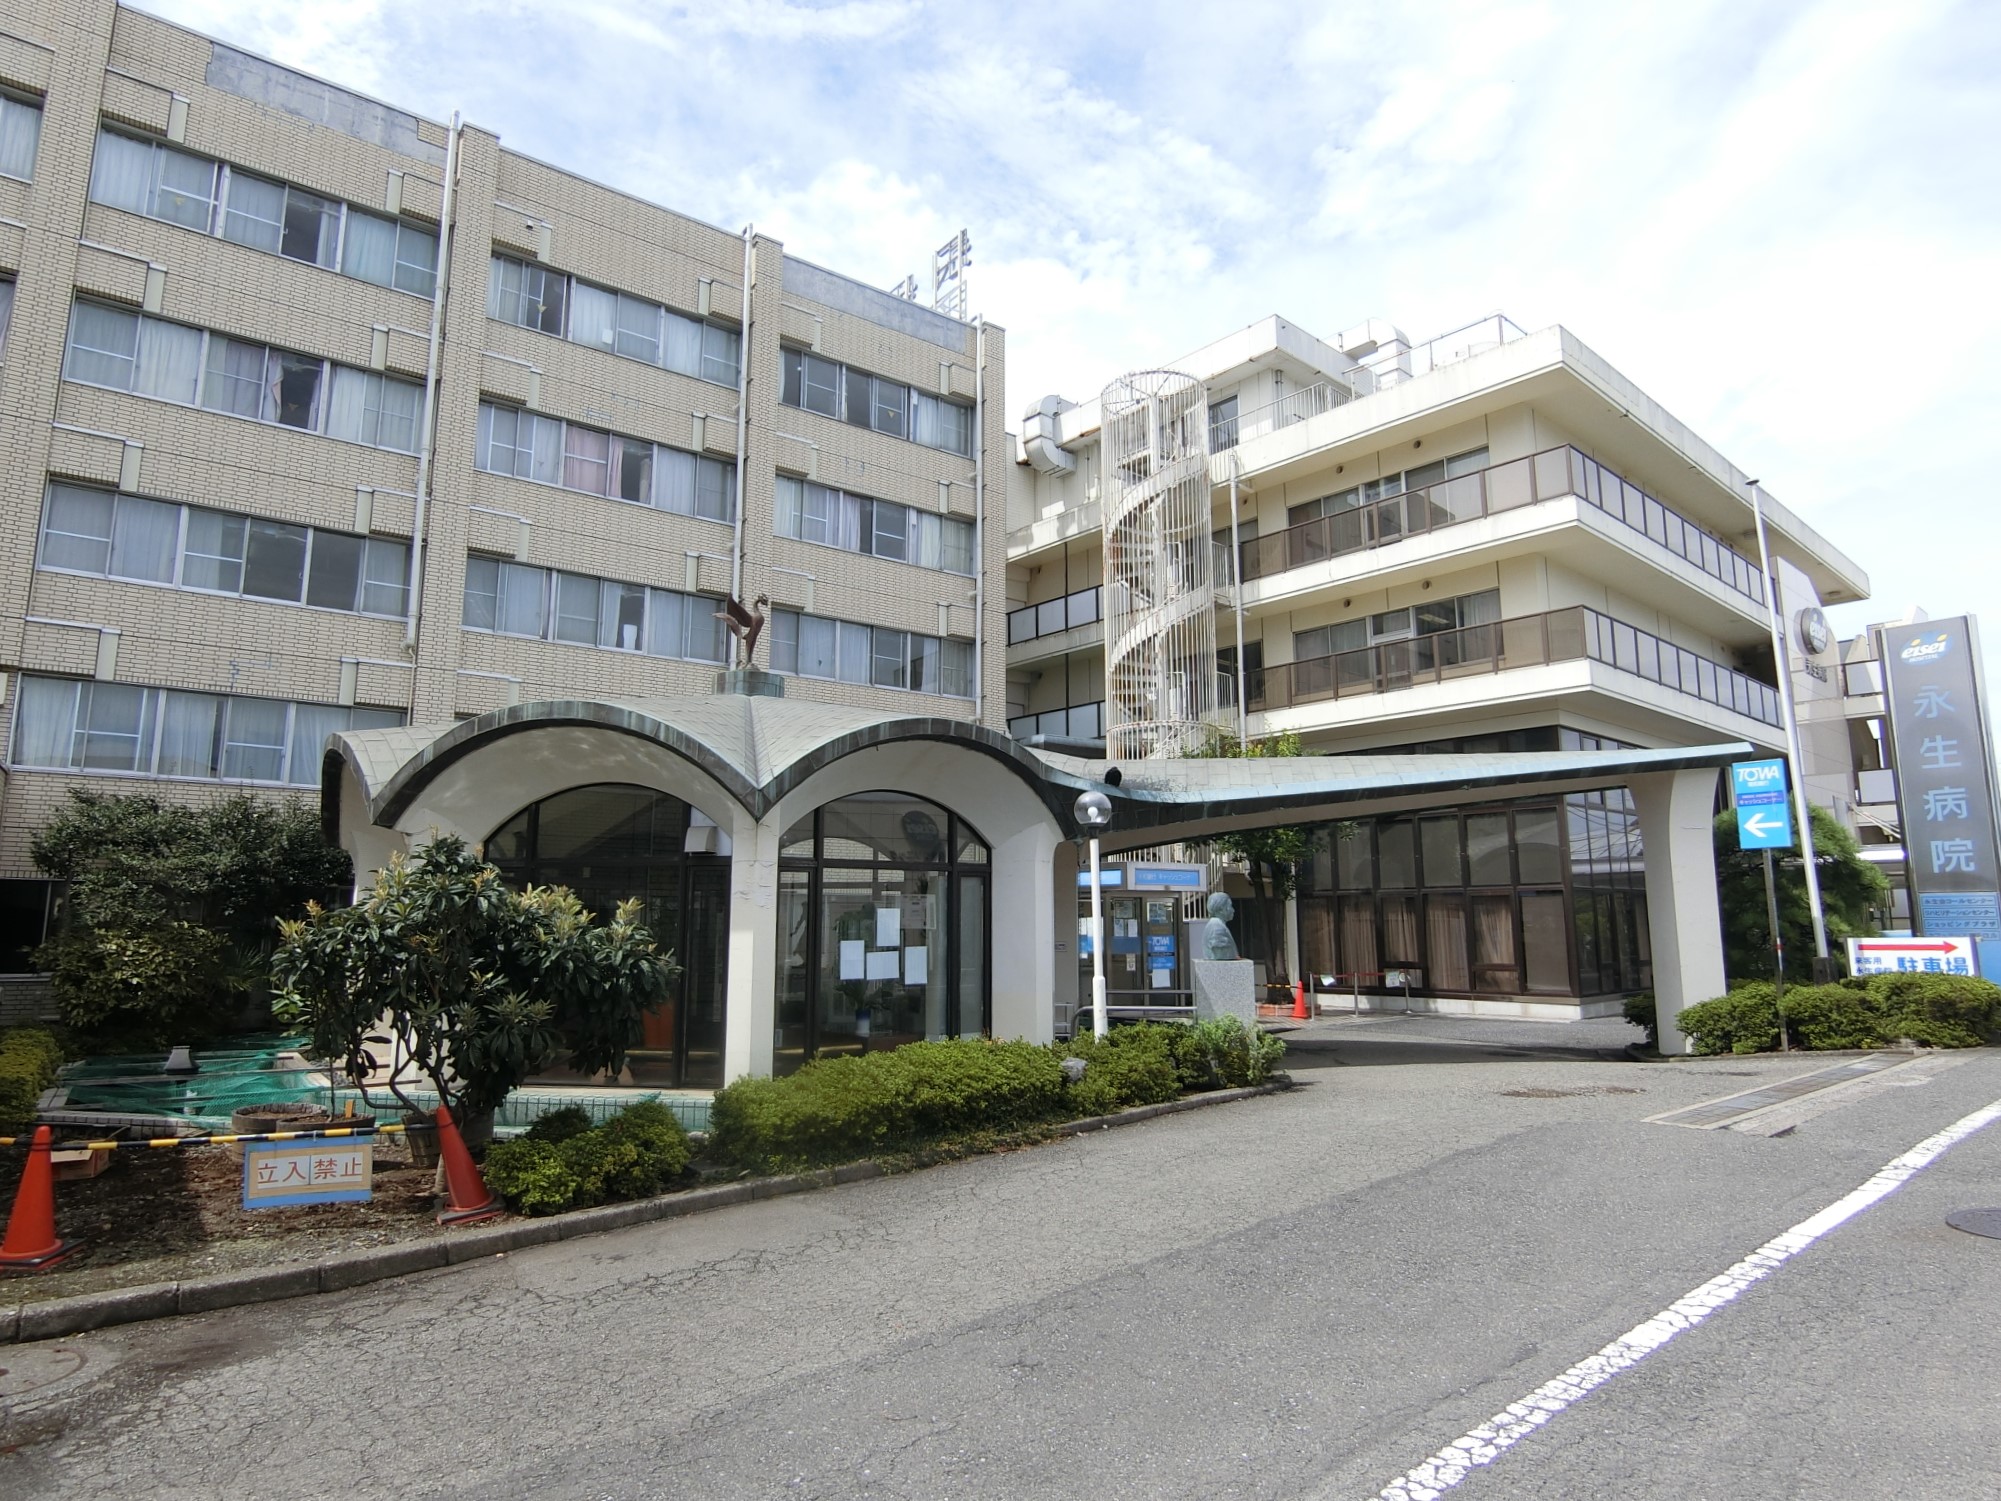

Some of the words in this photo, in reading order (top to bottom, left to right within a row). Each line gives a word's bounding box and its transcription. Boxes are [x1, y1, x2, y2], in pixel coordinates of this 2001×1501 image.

[1901, 634, 1947, 658] eisei
[1736, 766, 1780, 782] TOWA
[1913, 685, 1976, 873] 永生病院
[1897, 956, 1969, 976] 駐車場
[258, 1157, 362, 1184] 立入禁止
